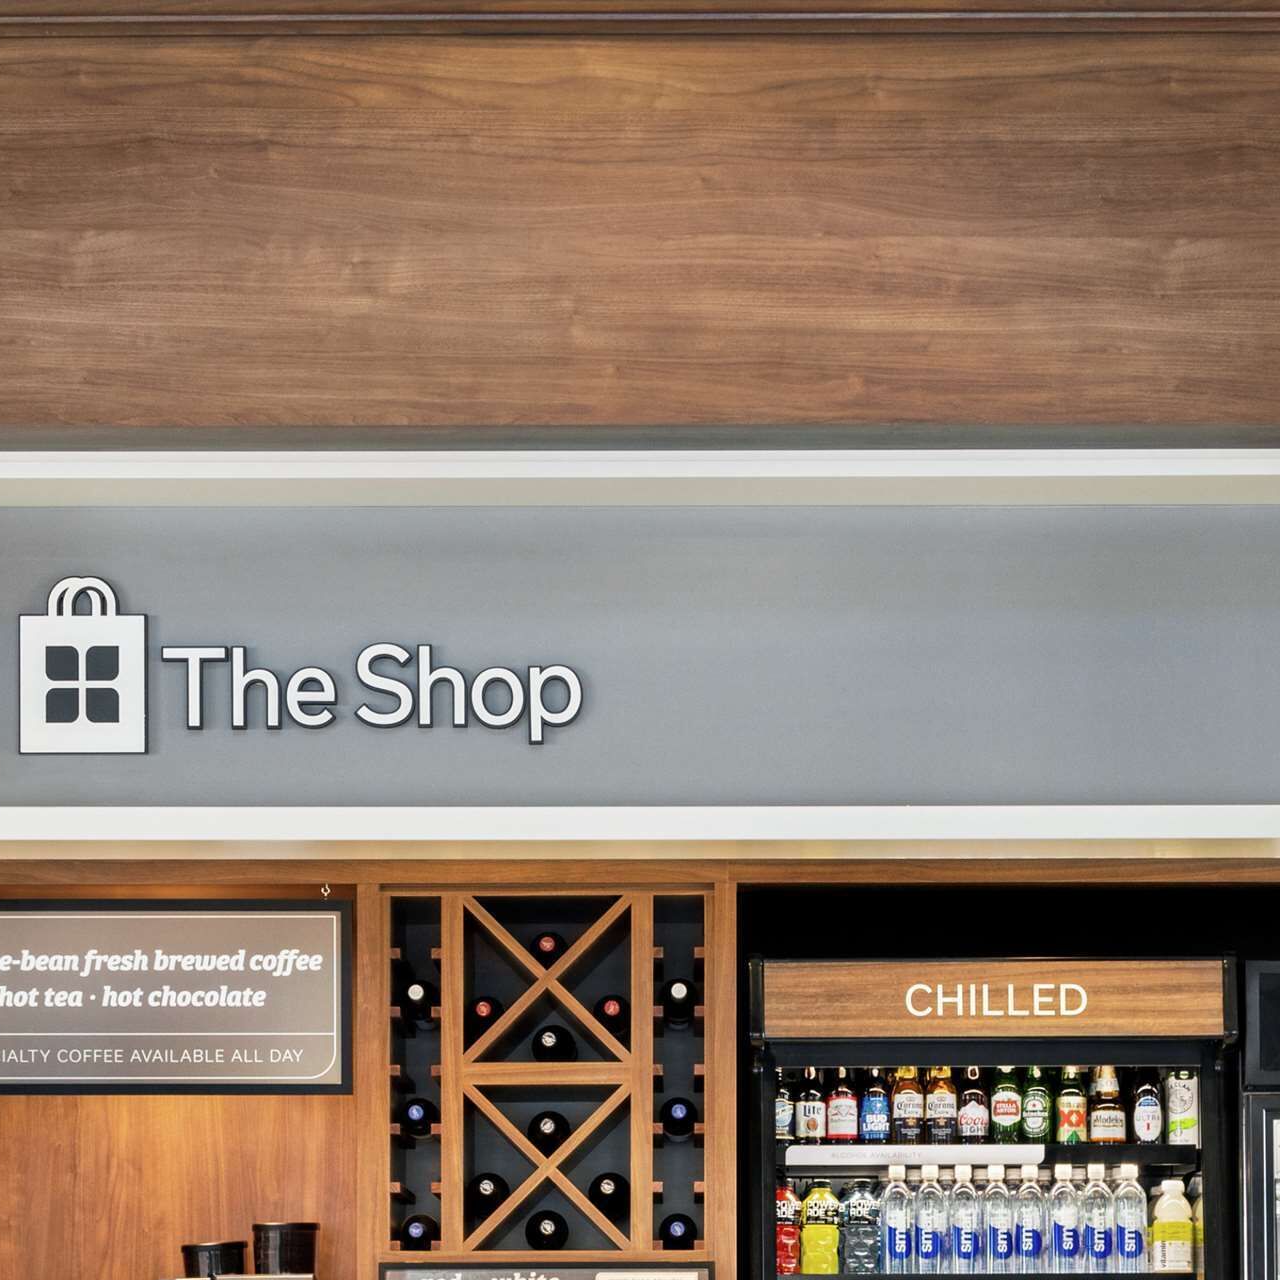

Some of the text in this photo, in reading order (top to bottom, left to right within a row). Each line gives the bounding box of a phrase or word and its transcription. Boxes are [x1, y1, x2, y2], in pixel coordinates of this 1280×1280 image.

[162, 642, 583, 745] The Shop
[81, 949, 148, 977] fresh
[154, 949, 245, 971] brewed
[250, 949, 322, 977] coffee
[44, 987, 83, 1007] tea
[102, 985, 143, 1007] hot
[148, 985, 266, 1007] chocolate
[905, 983, 1087, 1017] CHILLED
[57, 1048, 123, 1064] COFFEE
[130, 1048, 225, 1064] AVAILABLE
[231, 1048, 263, 1063] ALL
[270, 1047, 303, 1063] DAY
[803, 1105, 822, 1117] Lite
[865, 1114, 888, 1123] BUD
[863, 1122, 889, 1131] LIGHT
